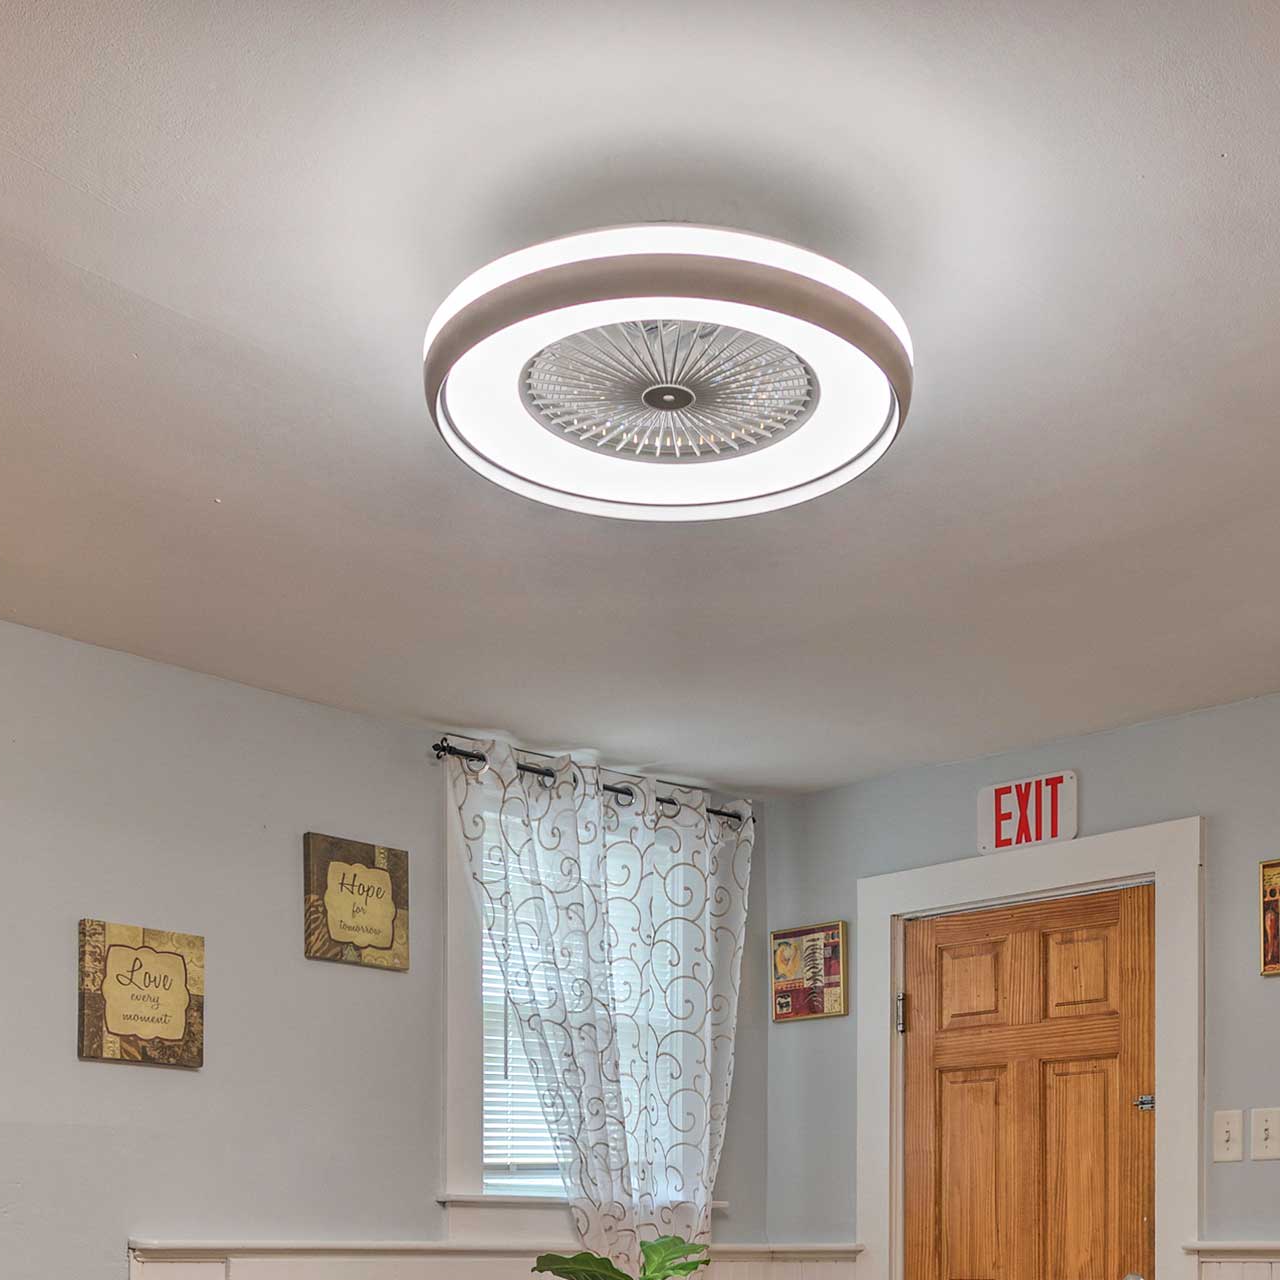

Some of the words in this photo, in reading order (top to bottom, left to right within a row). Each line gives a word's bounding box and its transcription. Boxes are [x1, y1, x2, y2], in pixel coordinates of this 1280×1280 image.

[995, 776, 1064, 848] EXIT
[338, 872, 386, 905] Hope
[351, 902, 366, 919] for
[339, 919, 382, 937] tomorrow
[116, 957, 174, 991] Love
[130, 992, 161, 1010] every
[122, 1012, 173, 1025] moment
